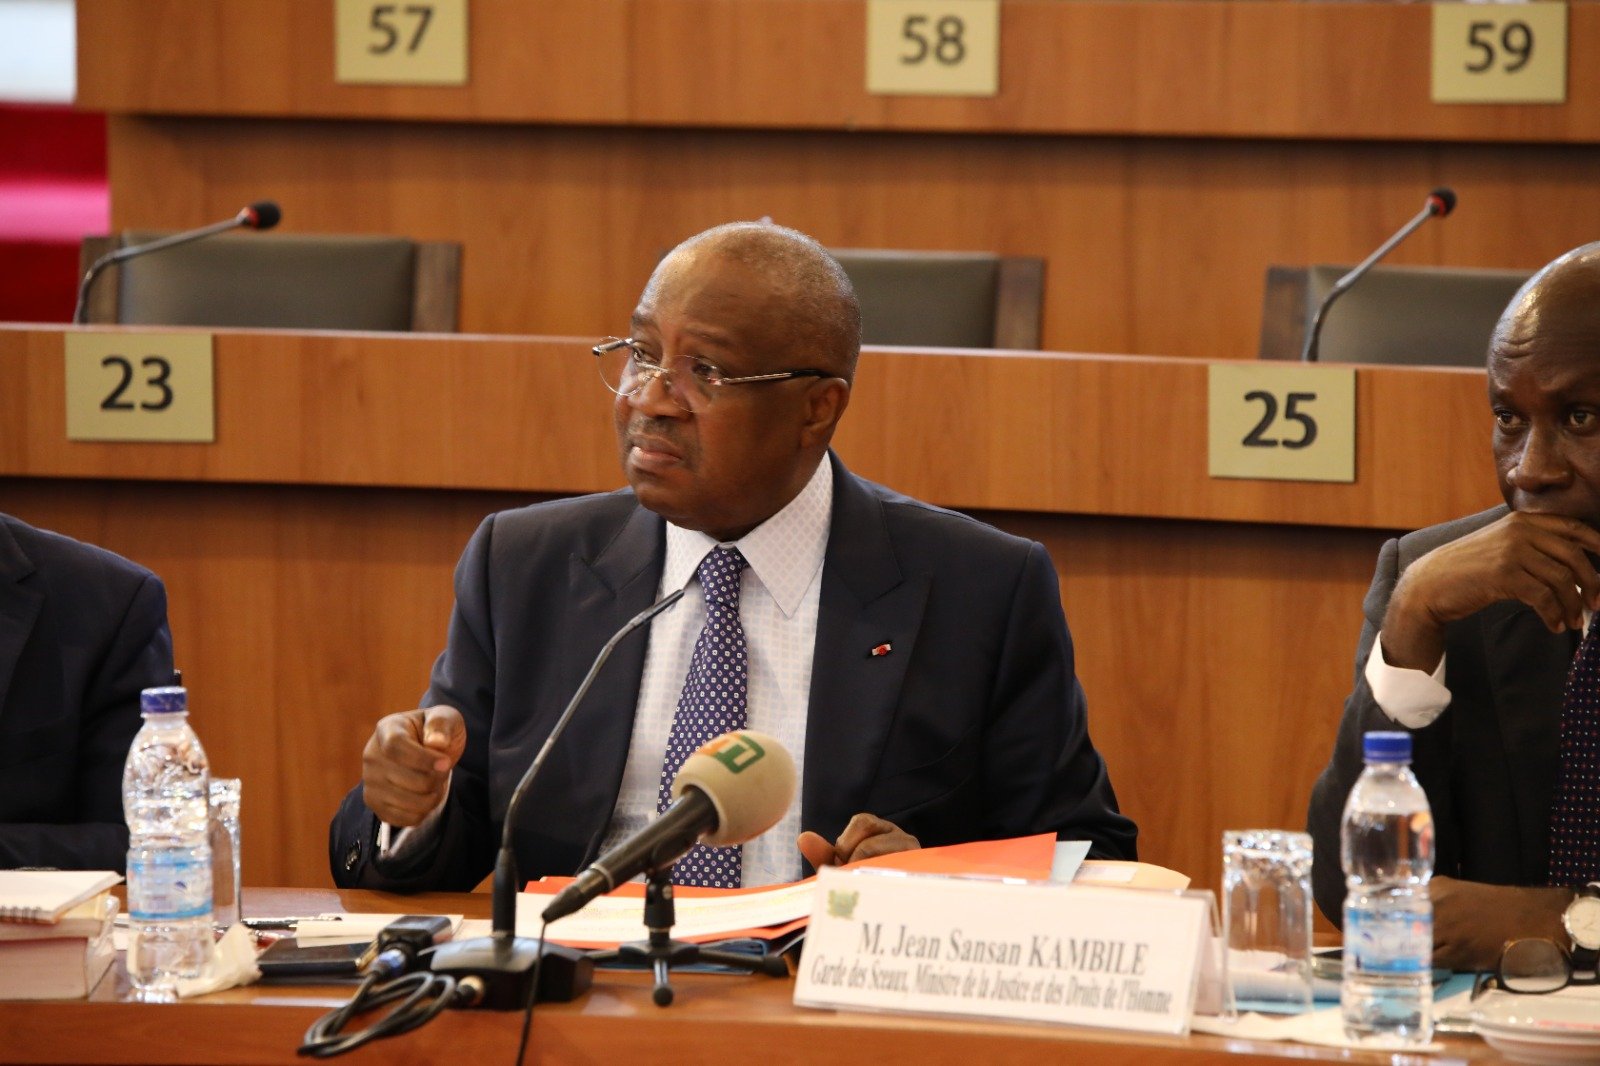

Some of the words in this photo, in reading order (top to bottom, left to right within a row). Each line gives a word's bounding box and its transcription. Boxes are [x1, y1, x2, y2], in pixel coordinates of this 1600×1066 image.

[370, 5, 433, 55] 57
[902, 14, 966, 66] 58
[1467, 21, 1535, 73] 59
[100, 355, 174, 412] 23
[1241, 390, 1318, 450] 25
[858, 922, 884, 955] M.
[891, 925, 941, 960] Jean
[946, 928, 1021, 967] Sansan
[1027, 934, 1149, 976] KAMBILE
[811, 954, 847, 987] Garde
[848, 959, 867, 989] des
[914, 963, 961, 998] Ministre
[963, 969, 977, 998] de
[977, 969, 990, 999] la
[990, 970, 1030, 1003] Justice
[1031, 977, 1044, 1003] et
[1044, 975, 1064, 1006] des
[1065, 975, 1101, 1008] Droits
[1102, 979, 1117, 1010] de
